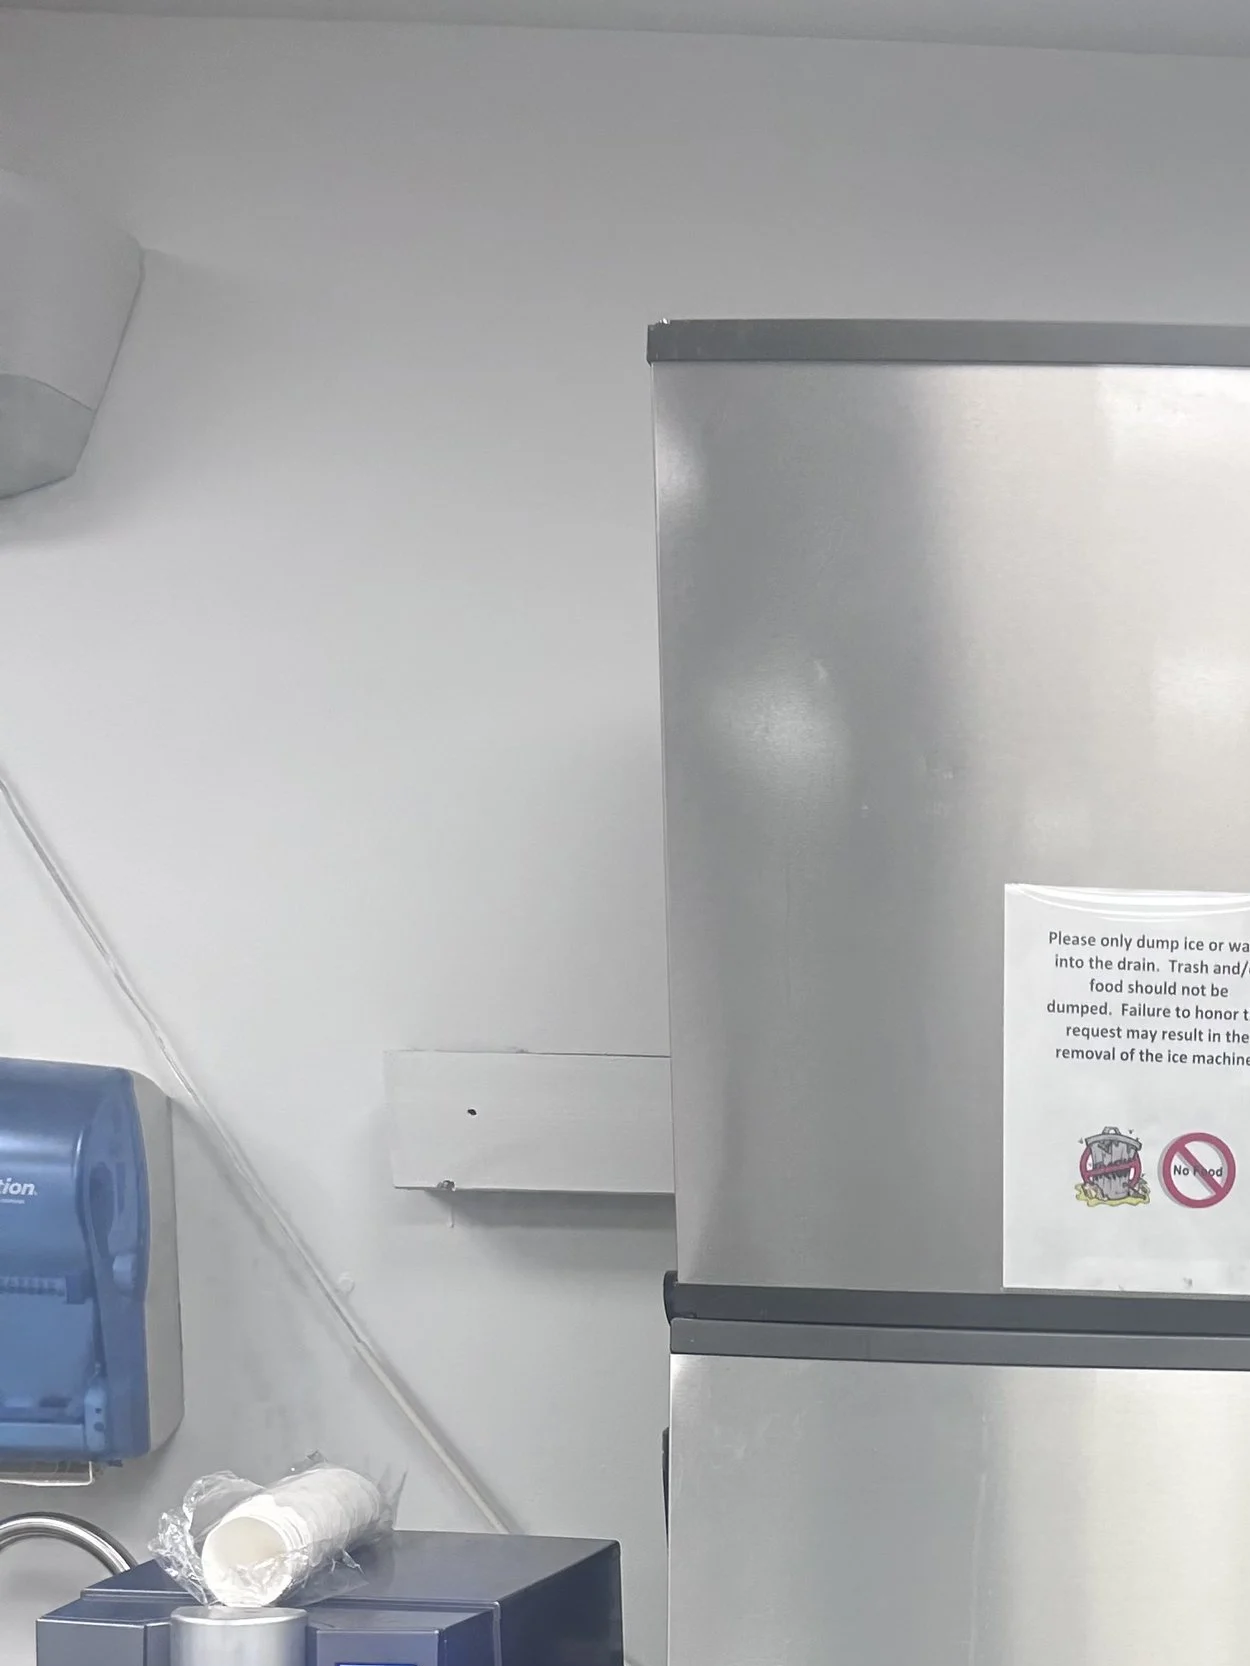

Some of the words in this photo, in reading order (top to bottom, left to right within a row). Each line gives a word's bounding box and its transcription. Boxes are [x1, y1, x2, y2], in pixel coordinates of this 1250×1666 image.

[1050, 931, 1095, 947] Please
[1101, 934, 1132, 952] only
[1137, 935, 1179, 953] dump
[1185, 937, 1204, 951] ice
[1209, 942, 1224, 952] or
[1056, 954, 1083, 969] into
[1089, 956, 1112, 970] the
[1118, 957, 1159, 972] drain.
[1169, 960, 1208, 974] Trash
[1090, 979, 1122, 993] food
[1129, 981, 1176, 996] should
[1182, 985, 1205, 997] not
[1211, 984, 1228, 998] be
[1047, 1000, 1111, 1018] dumped.
[1122, 1004, 1170, 1018] Failure
[1176, 1007, 1190, 1019] to
[1196, 1006, 1238, 1021] honor
[1067, 1027, 1121, 1040] request
[1127, 1030, 1157, 1043] may
[1162, 1028, 1203, 1042] result
[1209, 1029, 1220, 1043] in
[1226, 1030, 1249, 1044] the
[1056, 1047, 1115, 1061] removal
[1121, 1048, 1135, 1062] of
[1139, 1049, 1162, 1063] the
[1168, 1050, 1187, 1064] ice
[1173, 1165, 1189, 1176] No
